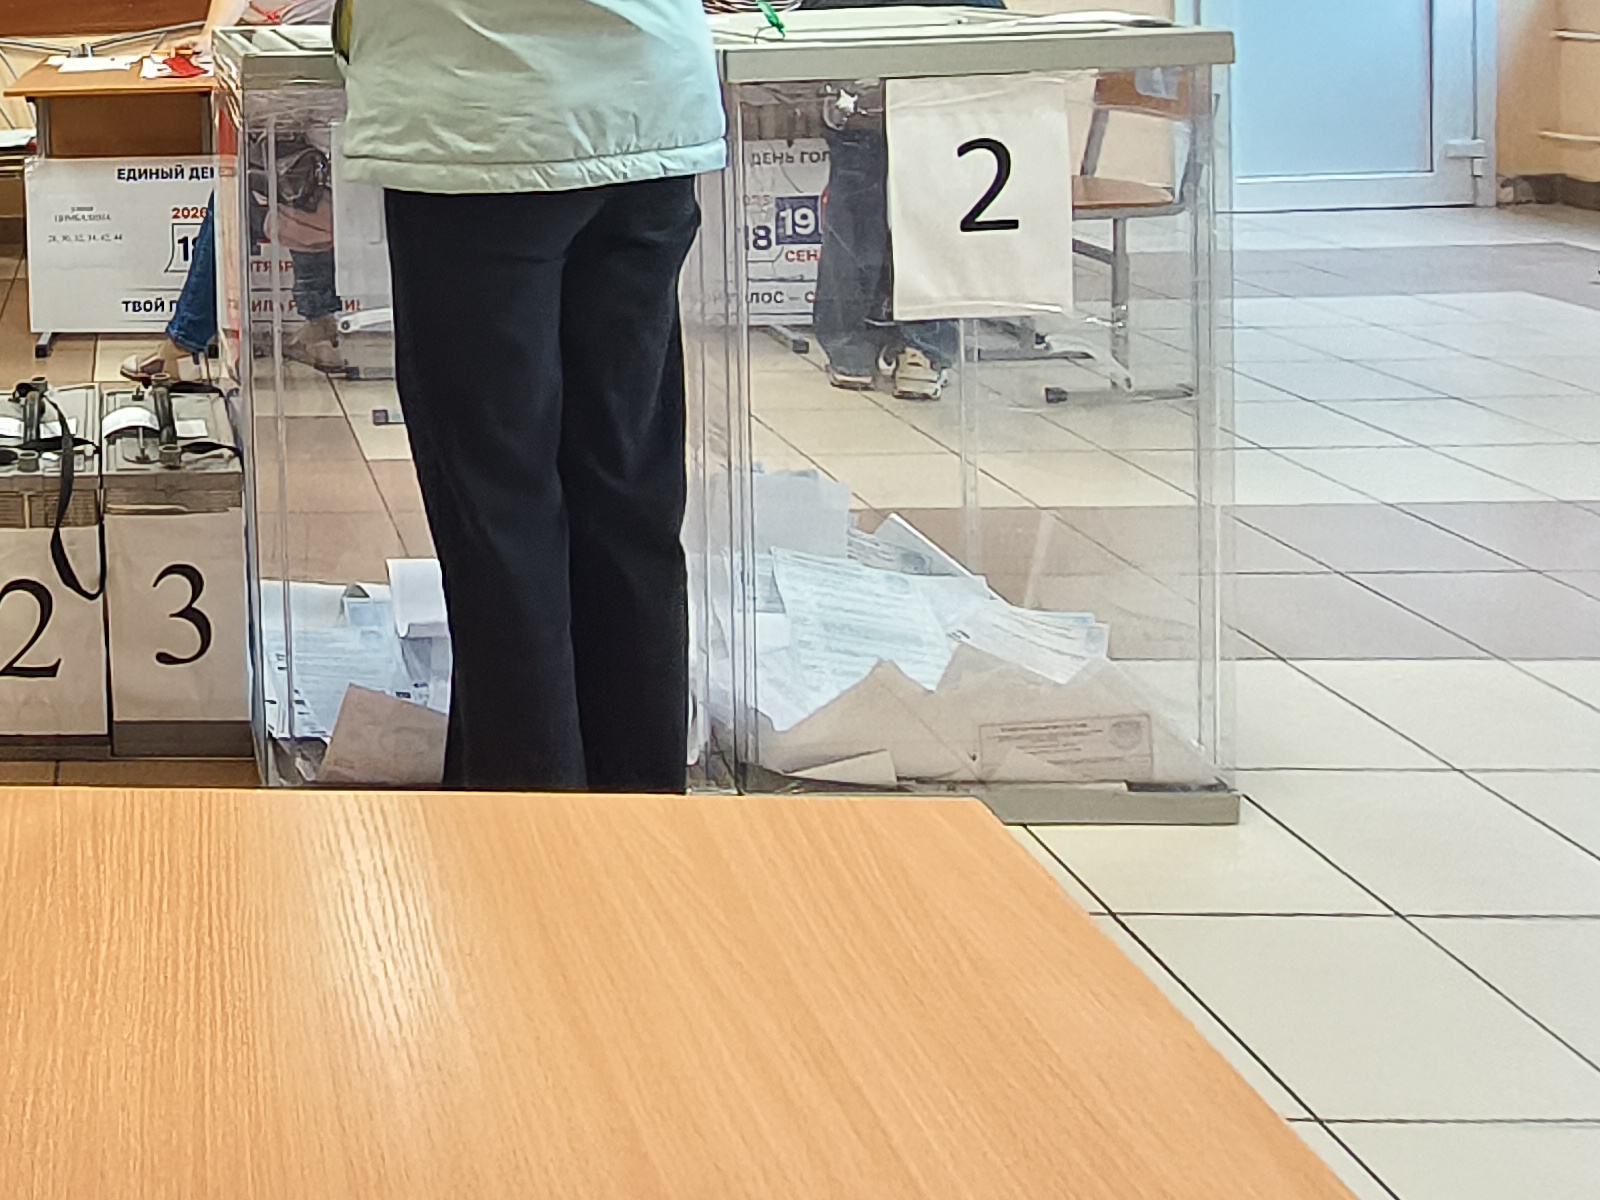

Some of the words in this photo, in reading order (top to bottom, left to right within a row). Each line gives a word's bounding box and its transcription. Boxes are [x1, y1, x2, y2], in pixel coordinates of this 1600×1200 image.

[117, 164, 184, 181] ЕДИНЫЙ
[957, 138, 1020, 232] 2
[779, 207, 816, 237] 19
[177, 236, 199, 261] 1
[122, 296, 165, 313] ТВОЙ
[153, 563, 212, 665] 3
